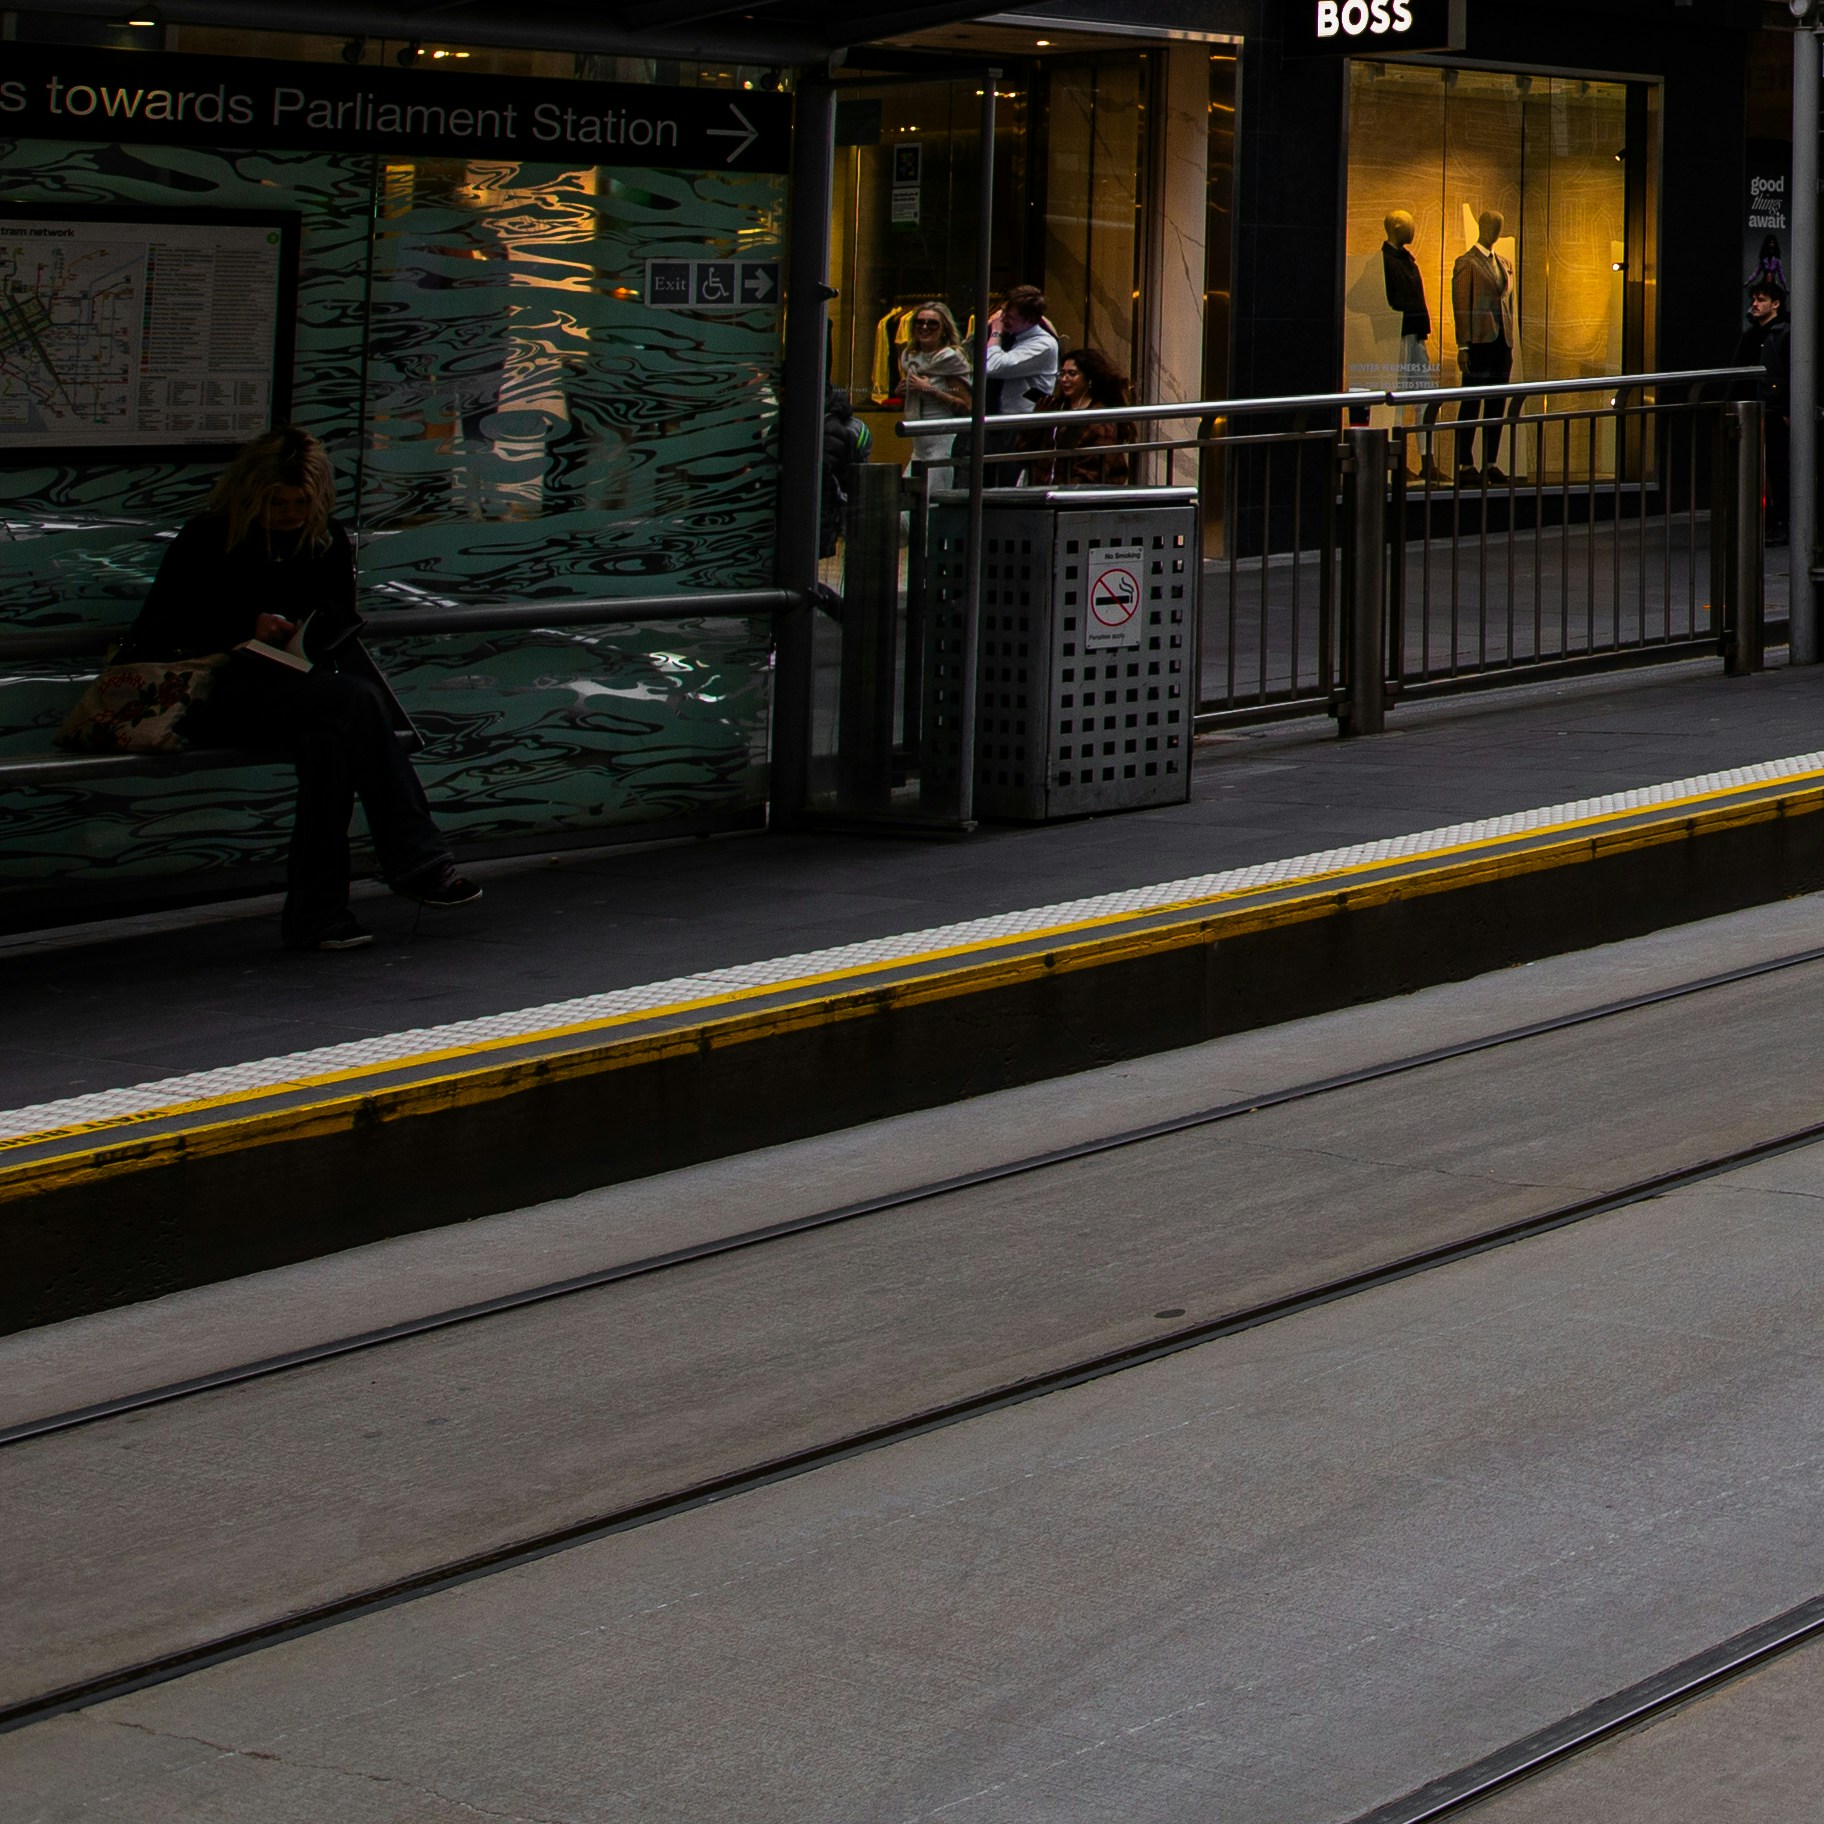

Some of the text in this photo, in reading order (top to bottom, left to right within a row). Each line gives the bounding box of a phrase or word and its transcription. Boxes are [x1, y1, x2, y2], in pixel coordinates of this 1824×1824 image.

[47, 75, 254, 125] towards
[272, 87, 518, 141] Parliament
[531, 102, 679, 148] Station
[1750, 176, 1784, 196] good
[1751, 192, 1783, 216] things
[1748, 212, 1786, 229] await
[29, 228, 75, 237] network
[654, 276, 687, 291] Exit
[1115, 552, 1141, 560] Smoking
